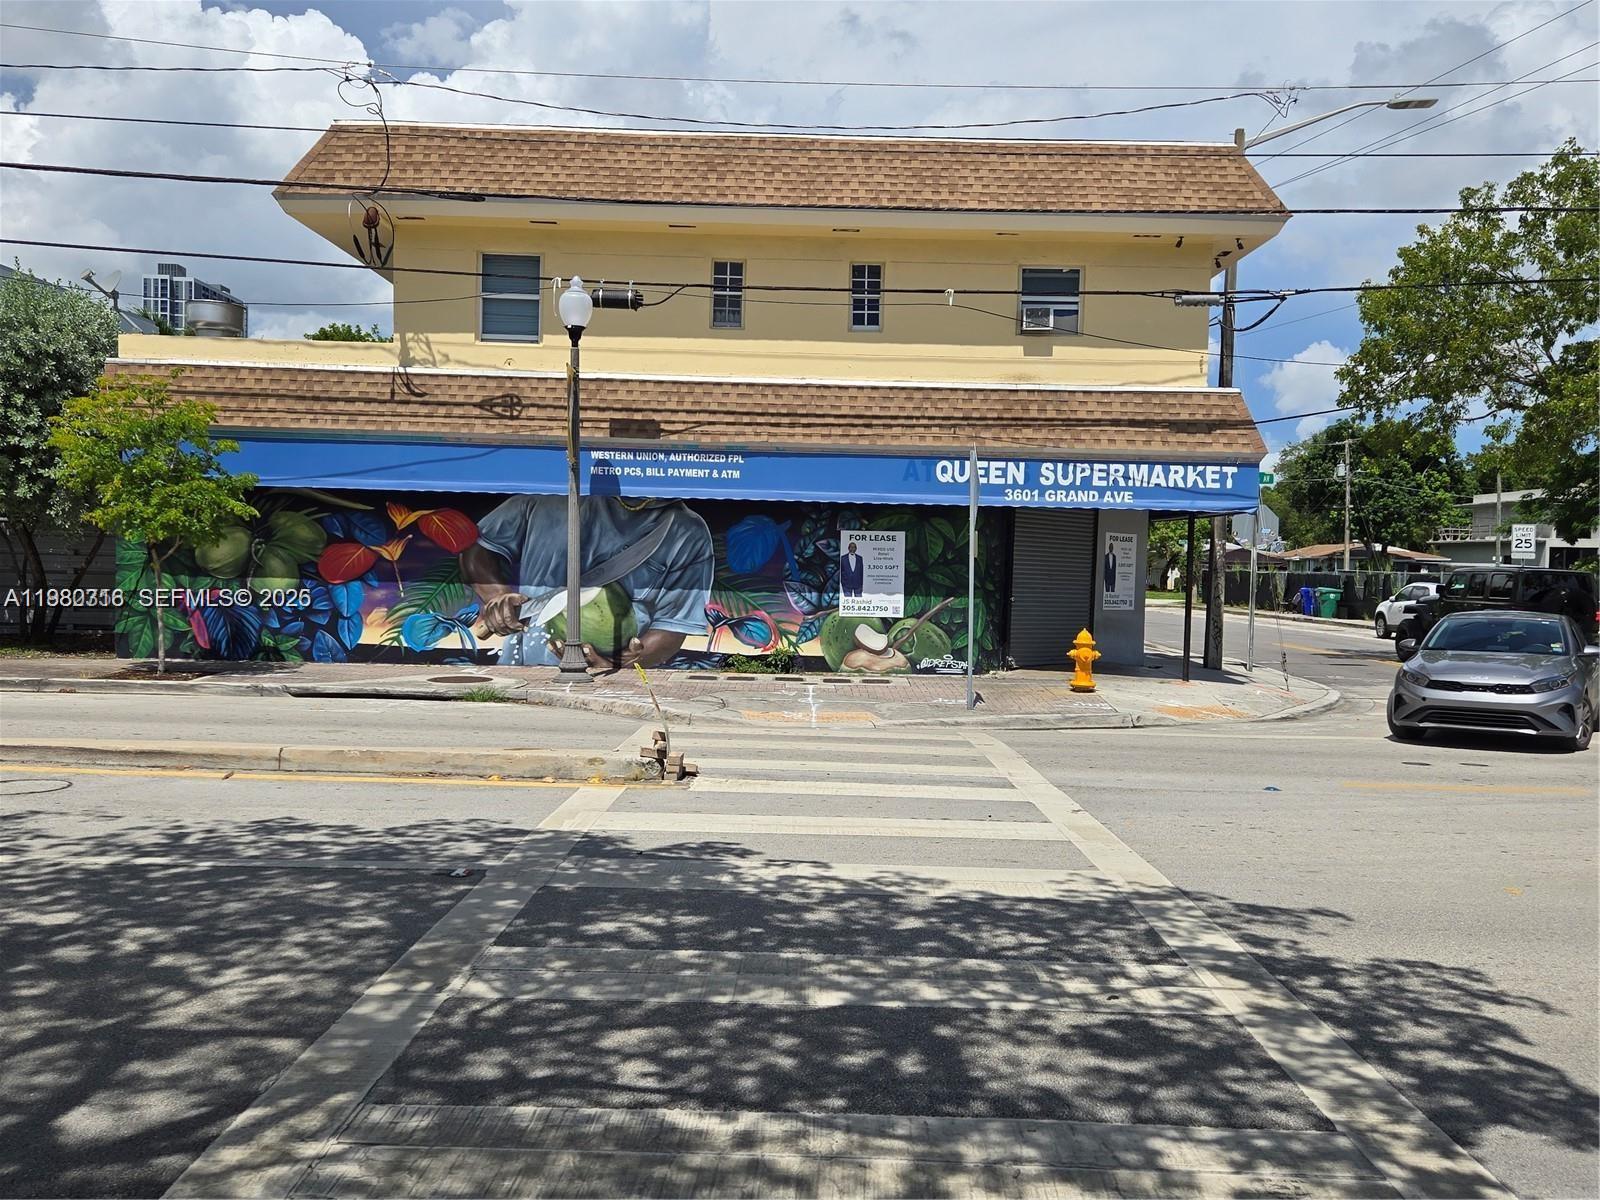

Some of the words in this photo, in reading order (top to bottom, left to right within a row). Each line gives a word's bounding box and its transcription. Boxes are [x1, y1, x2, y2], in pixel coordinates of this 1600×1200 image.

[591, 451, 634, 460] WESTERN
[636, 452, 667, 462] UNION,
[669, 453, 726, 463] AUTHORIZED
[728, 454, 744, 463] FPL
[590, 466, 621, 476] METRO
[624, 467, 644, 478] PCS,
[646, 467, 665, 477] BILL
[668, 468, 709, 478] PAYMENT
[712, 469, 719, 478] &
[721, 470, 740, 479] ATM
[935, 460, 1026, 486] QUEEN
[1040, 463, 1238, 489] SUPERMARKET
[1004, 489, 1039, 502] 3601
[1045, 490, 1099, 503] GRAND
[1103, 491, 1134, 504] AVE
[869, 534, 897, 542] LEASE
[1514, 538, 1532, 549] 25
